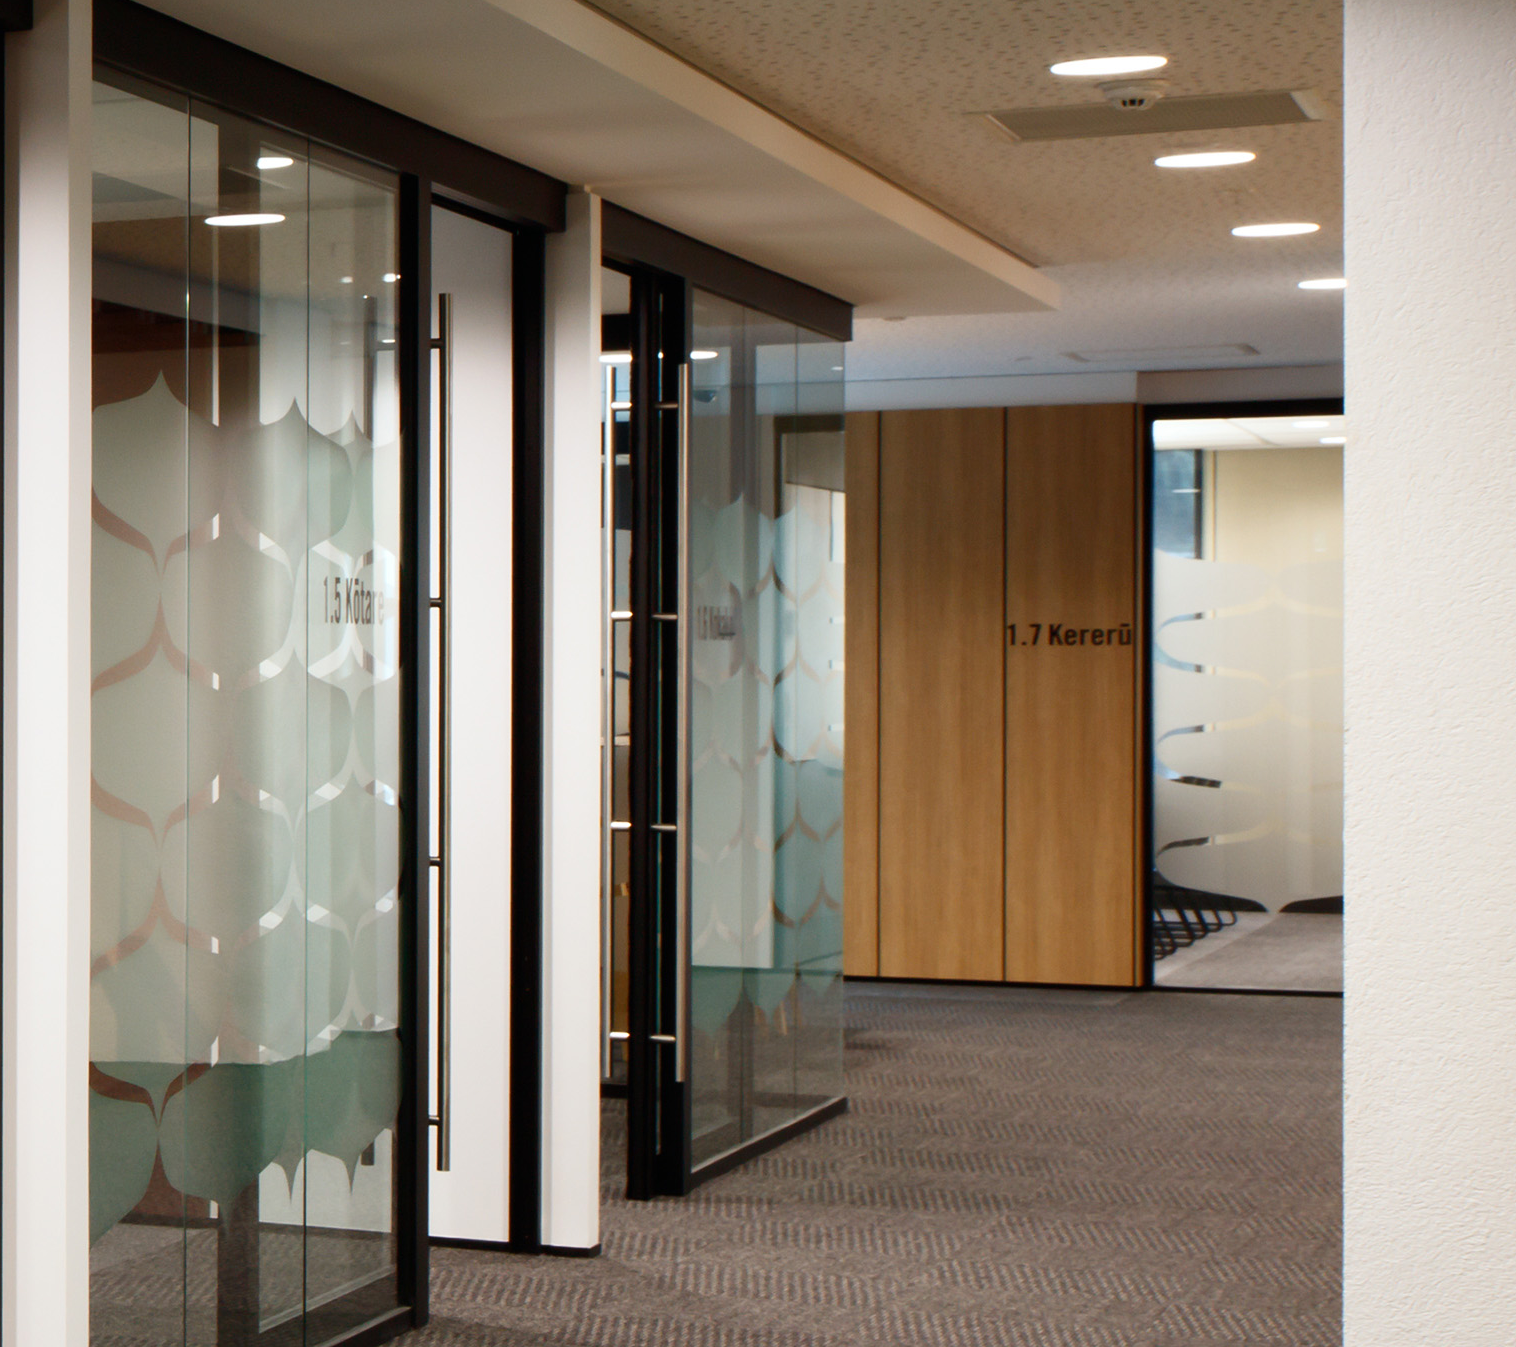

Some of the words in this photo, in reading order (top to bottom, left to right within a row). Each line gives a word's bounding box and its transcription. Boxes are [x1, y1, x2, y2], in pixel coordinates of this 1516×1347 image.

[323, 575, 341, 624] 1.5
[1007, 623, 1042, 646] 1.7
[1048, 622, 1133, 646] Kererū
